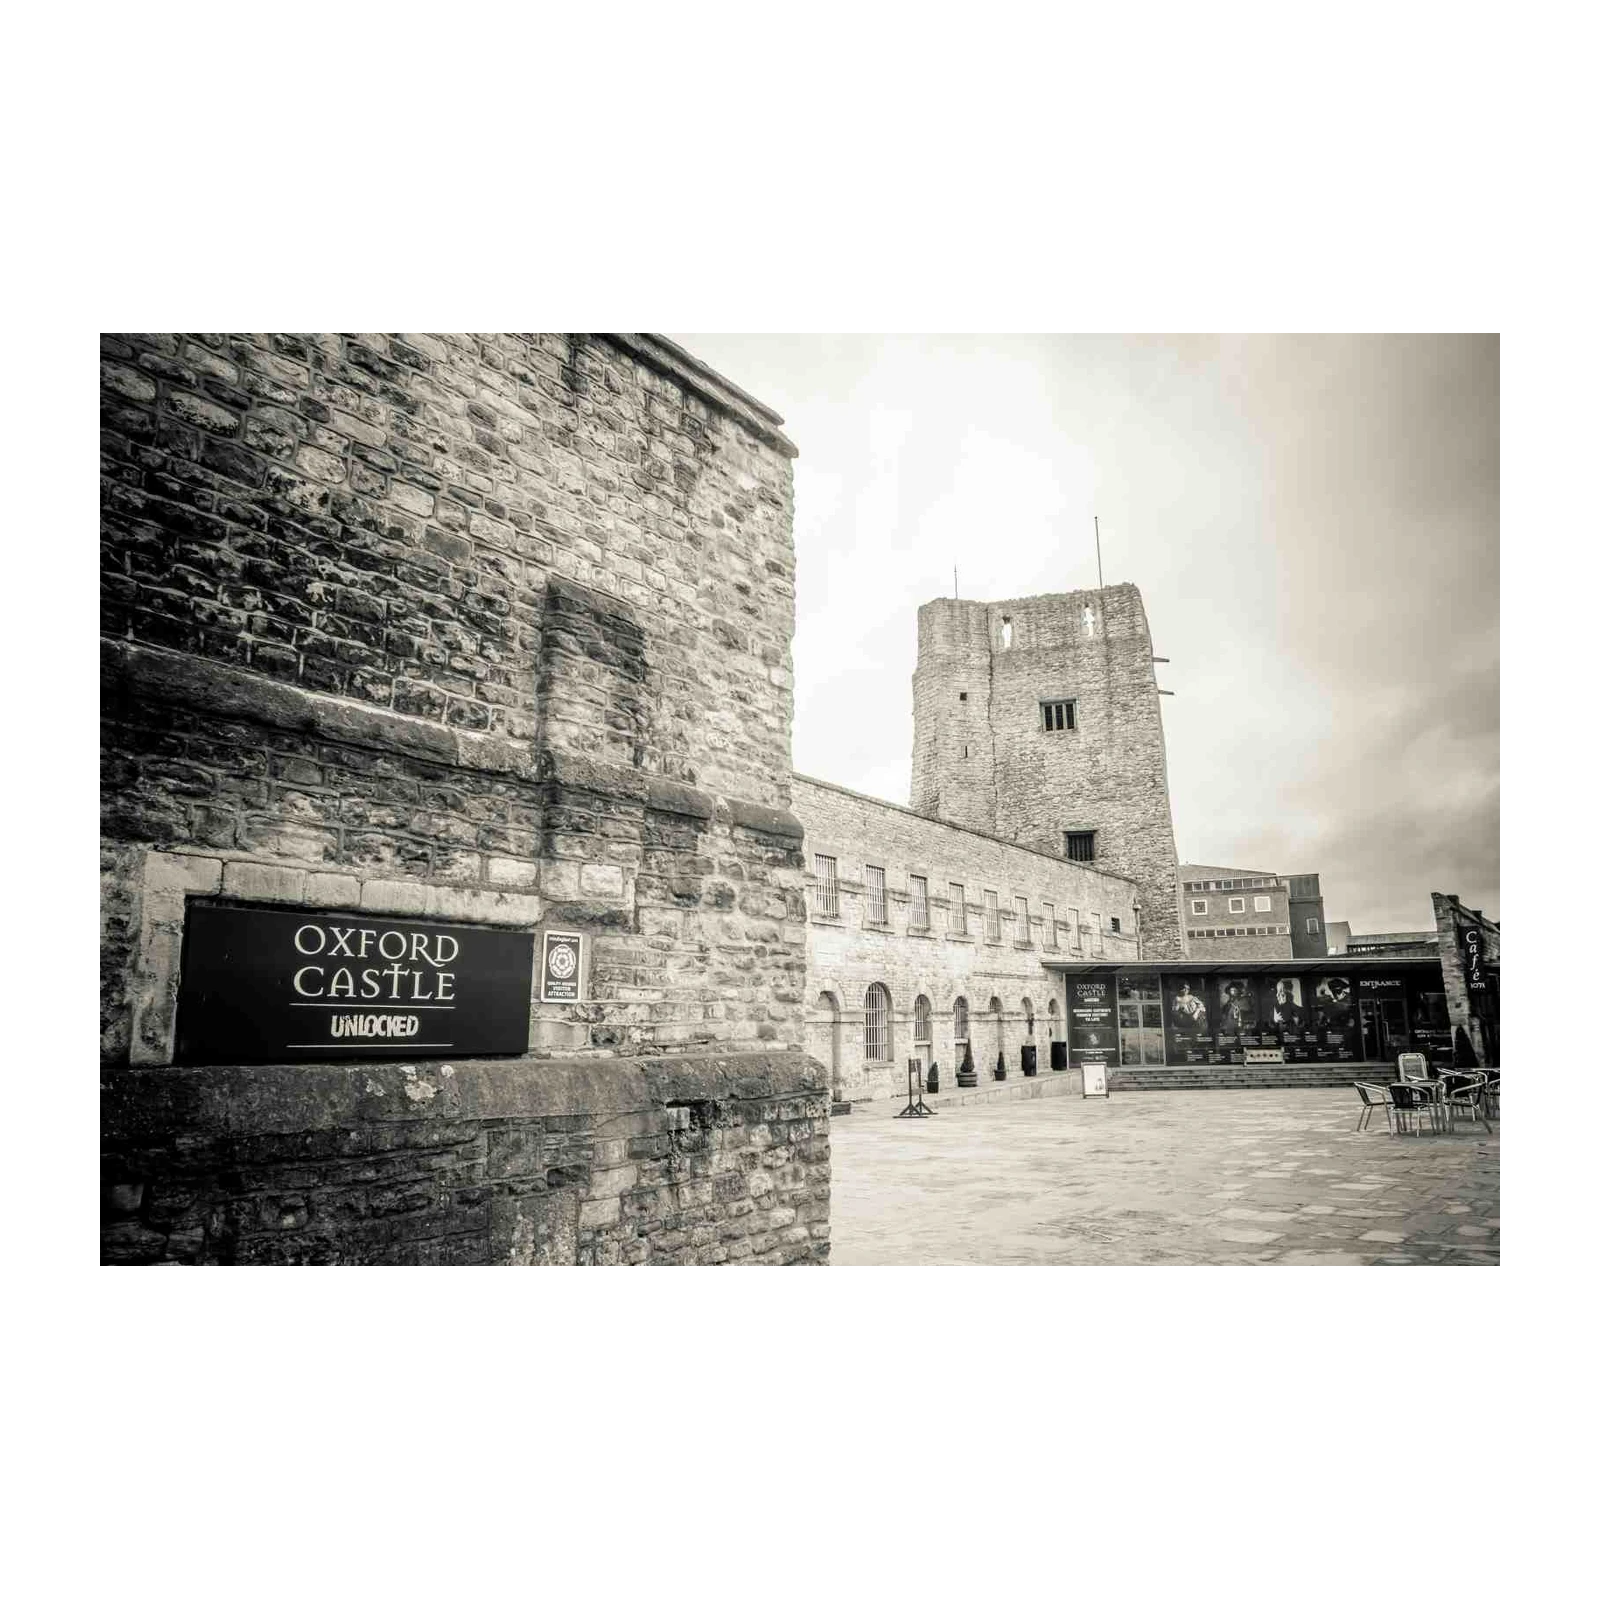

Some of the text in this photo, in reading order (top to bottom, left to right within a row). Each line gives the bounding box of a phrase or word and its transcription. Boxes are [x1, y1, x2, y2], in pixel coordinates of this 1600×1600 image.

[294, 924, 459, 968] OXFORD
[1466, 930, 1480, 981] Café
[293, 963, 456, 1000] CASTLE
[331, 1014, 419, 1037] UNLOCKED
